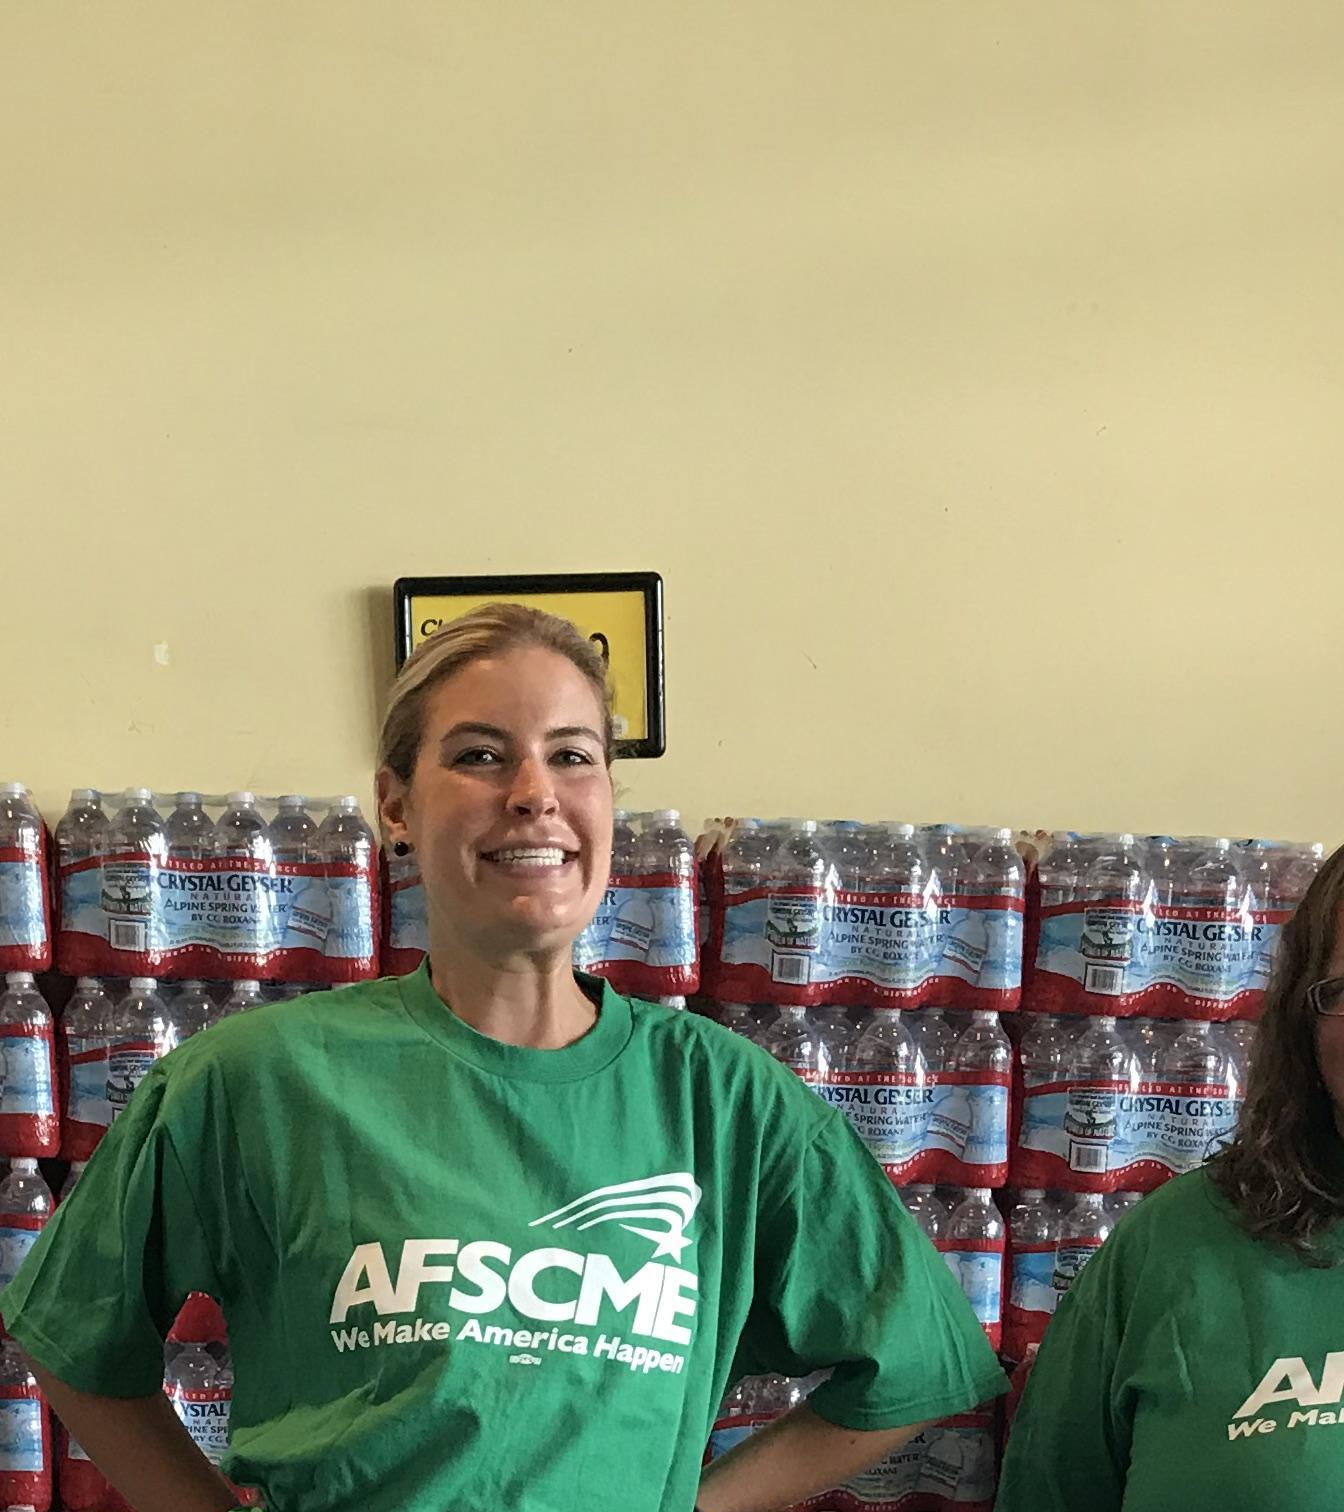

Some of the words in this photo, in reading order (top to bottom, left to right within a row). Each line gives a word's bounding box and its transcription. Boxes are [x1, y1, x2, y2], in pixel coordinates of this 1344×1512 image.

[157, 872, 225, 891] CRYSTAL
[227, 873, 293, 893] GEYSER
[329, 1239, 699, 1345] AFSCME
[331, 1326, 371, 1353] We
[373, 1318, 450, 1346] Make
[456, 1318, 588, 1356] America
[593, 1333, 685, 1375] Happen
[1227, 1417, 1277, 1441] We
